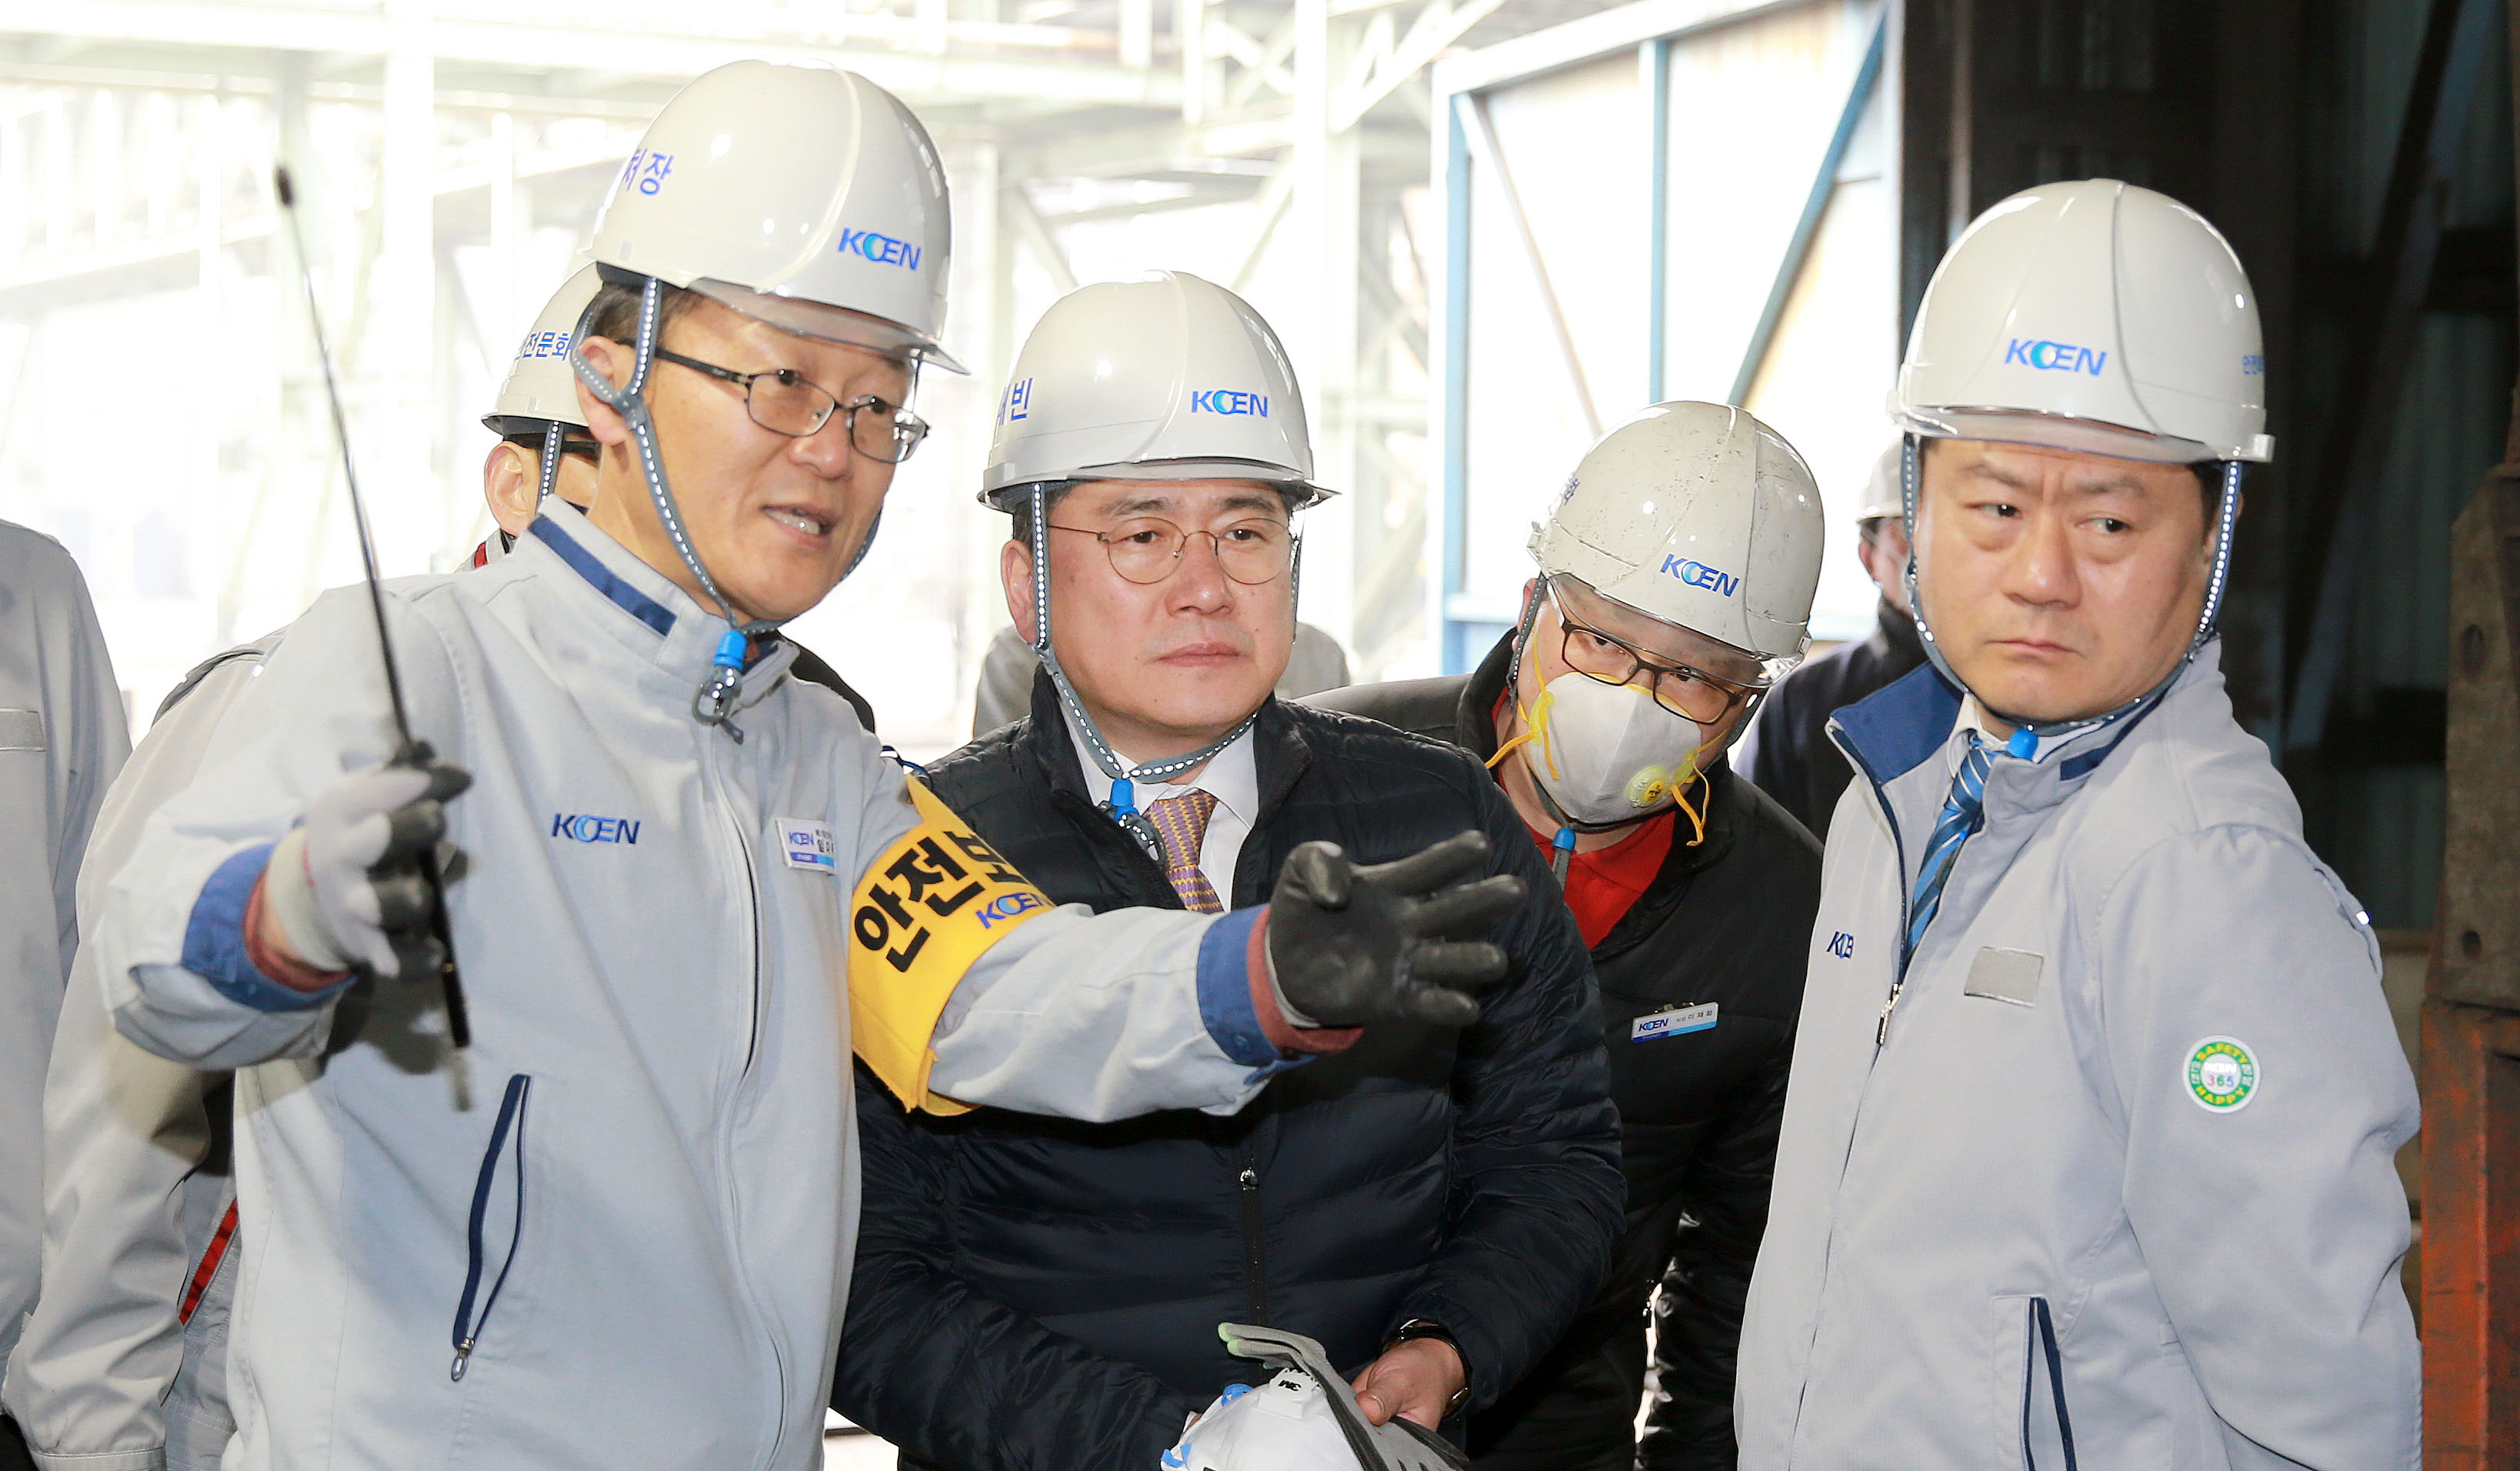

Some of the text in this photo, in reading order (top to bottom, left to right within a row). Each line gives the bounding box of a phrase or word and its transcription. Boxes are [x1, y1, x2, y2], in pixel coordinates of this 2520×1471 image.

[838, 228, 922, 270] KOEN
[515, 332, 573, 361] 전문화
[2003, 339, 2107, 375] KOEN
[1192, 390, 1268, 417] KOEN
[1659, 554, 1739, 596] KOEN
[551, 813, 640, 844] KOEN
[1639, 1019, 1668, 1032] KOEN
[2208, 1075, 2235, 1087] 365
